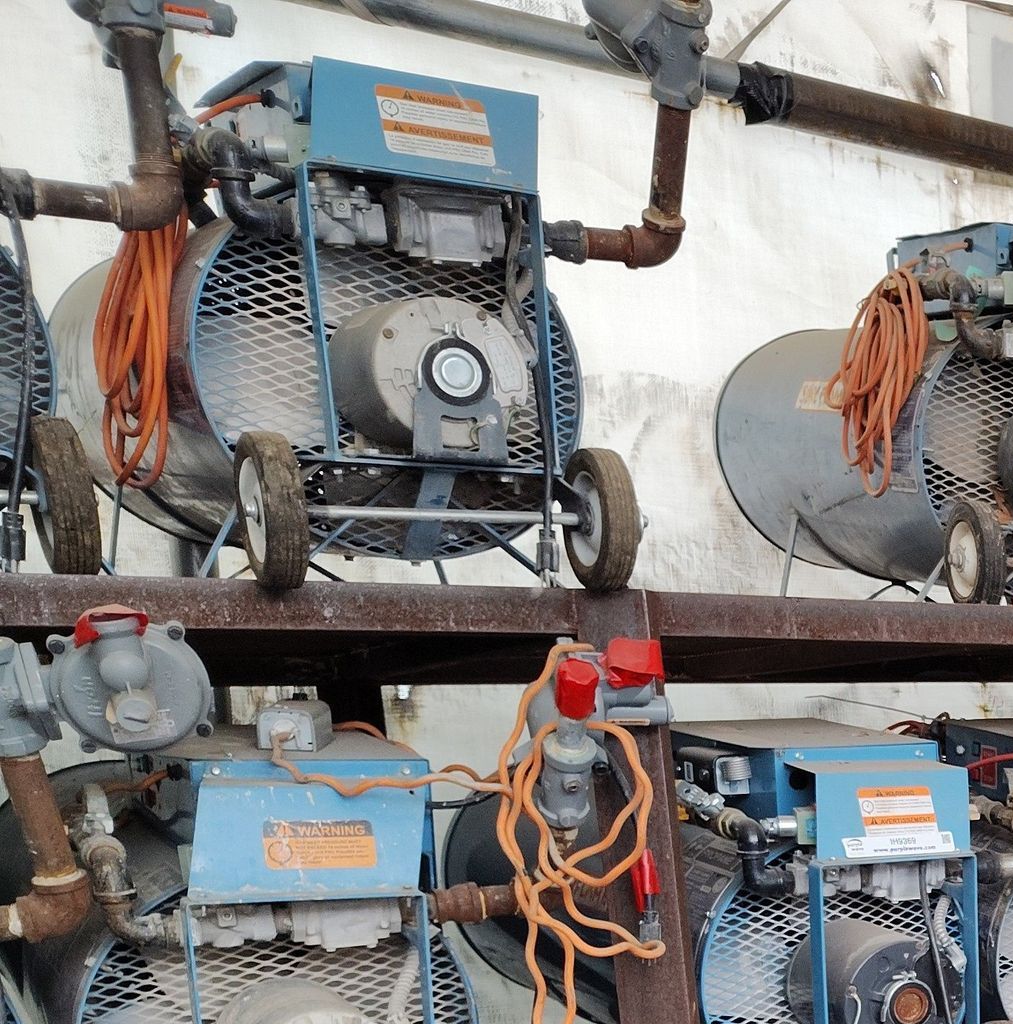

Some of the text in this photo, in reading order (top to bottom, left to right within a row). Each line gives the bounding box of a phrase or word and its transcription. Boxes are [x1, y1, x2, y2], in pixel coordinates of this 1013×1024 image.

[416, 95, 462, 108] WARNING
[408, 126, 484, 144] AVERTISSEMENT
[297, 825, 366, 837] WARNING
